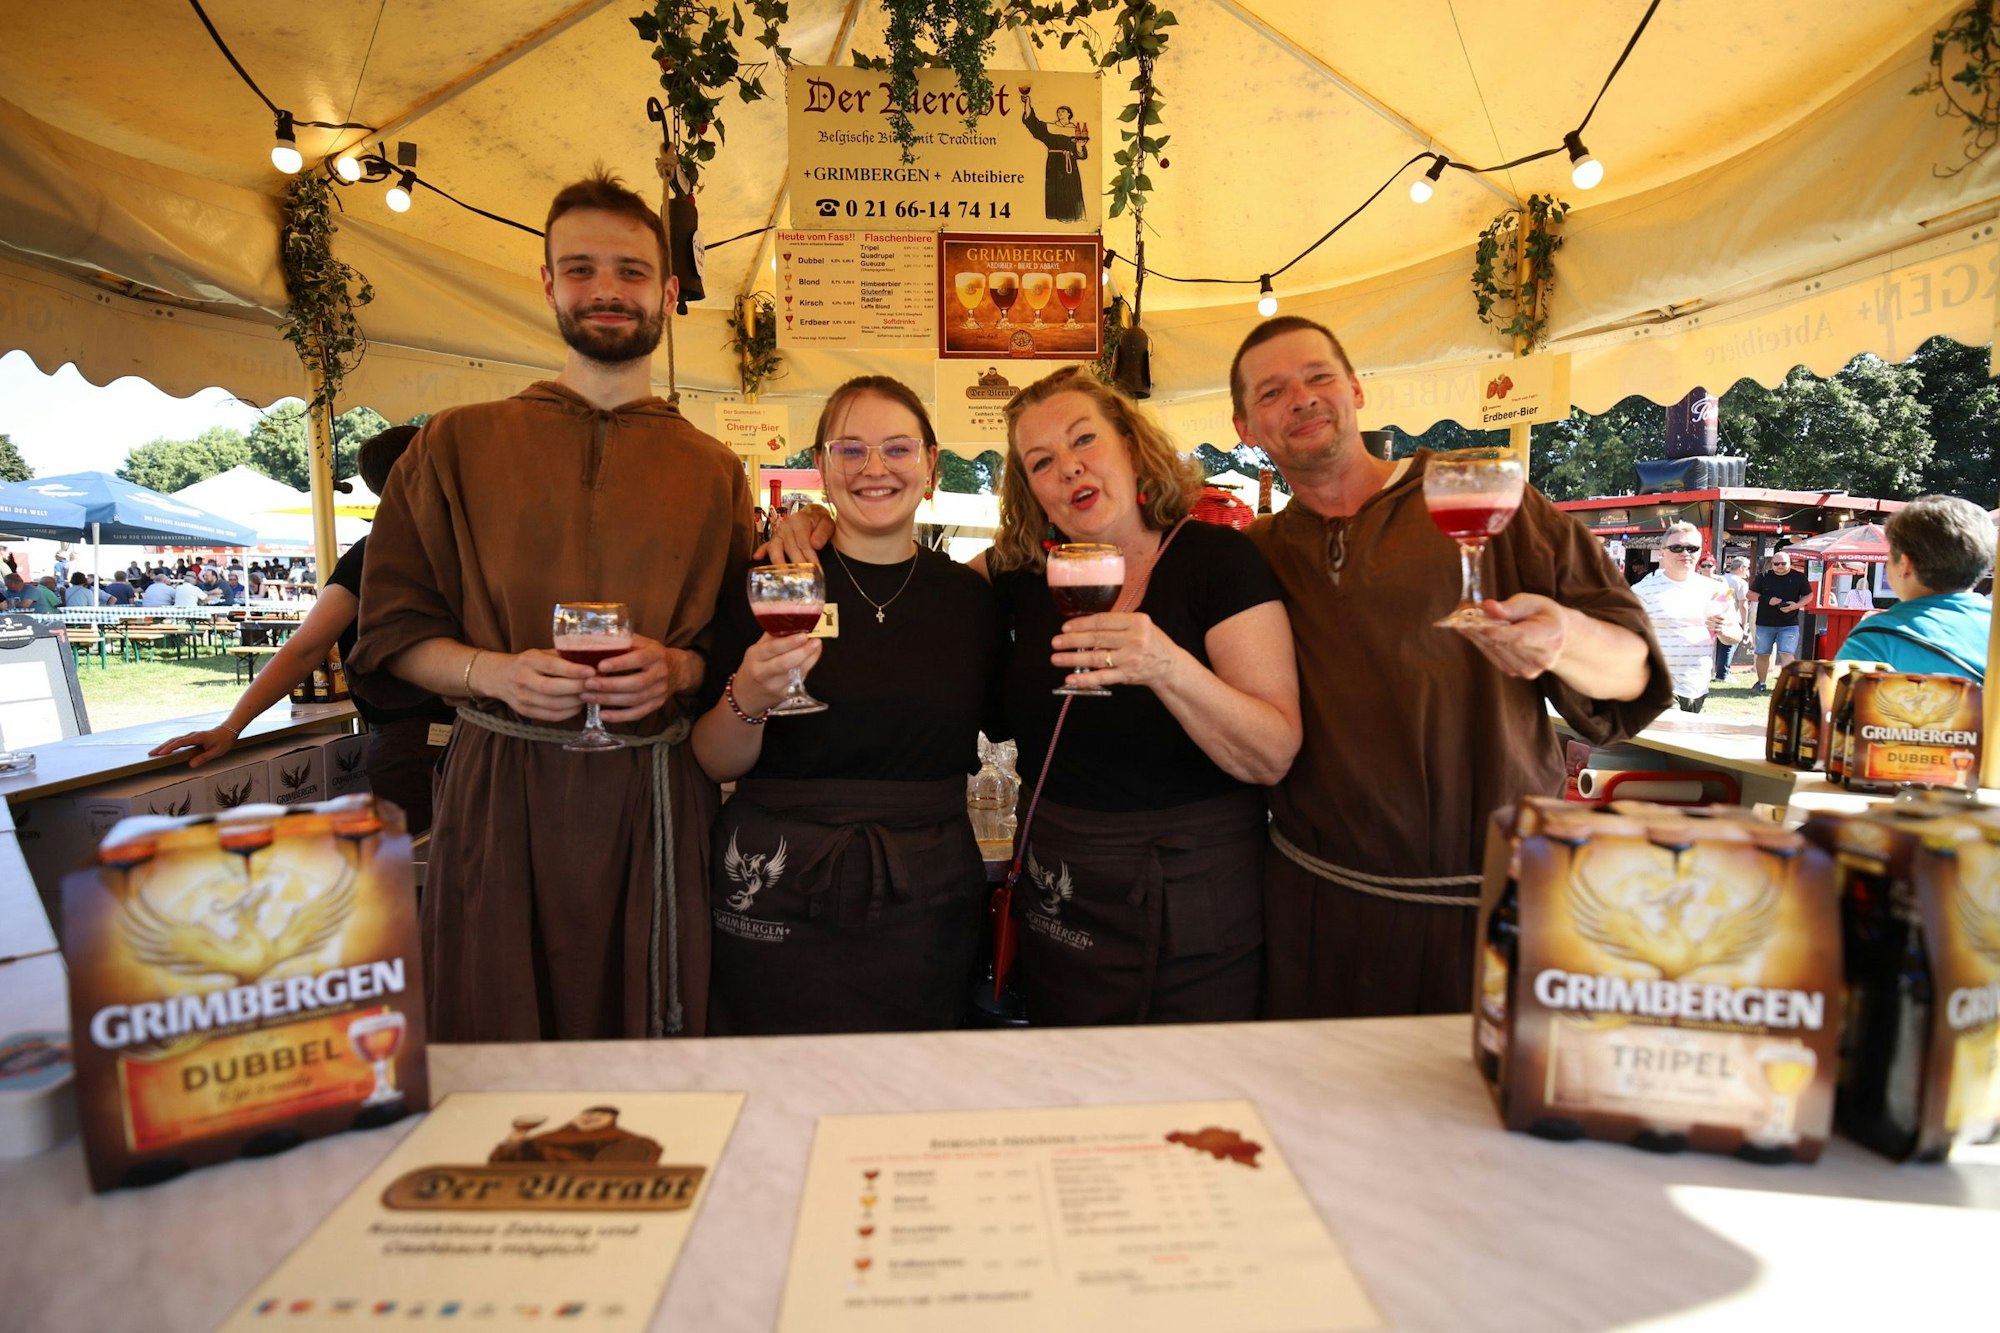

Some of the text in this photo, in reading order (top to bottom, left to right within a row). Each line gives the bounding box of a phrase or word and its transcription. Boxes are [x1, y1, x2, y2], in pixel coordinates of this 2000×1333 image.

[804, 76, 871, 113] Der
[818, 130, 875, 146] Belgische
[878, 131, 906, 145] Bie
[937, 132, 997, 146] Tradition
[951, 170, 1025, 184] Abteibiere
[846, 200, 1011, 219] 0 21 66-14 74 14
[777, 232, 805, 241] Heute
[828, 232, 855, 242] Fass!!
[864, 233, 932, 243] Flaschenbiere
[860, 252, 895, 260] Quadrupel
[966, 248, 1075, 262] GRIMBERGEN
[799, 278, 820, 286] Blond
[971, 389, 984, 397] Der
[1483, 406, 1539, 423] Erdbeer-Bier
[726, 423, 780, 432] Cherry-Bier
[30, 508, 49, 516] WELT
[1861, 725, 1978, 745] GRIMBERGEN
[1887, 751, 1947, 766] DUBBEL
[90, 957, 405, 1050] GRIMBERGEN
[1534, 968, 1825, 1030] GRIMBERGEN
[180, 1036, 344, 1093] DUBBEL
[1610, 1042, 1735, 1079] TRIPEL
[412, 1172, 692, 1201] Der Bierabt
